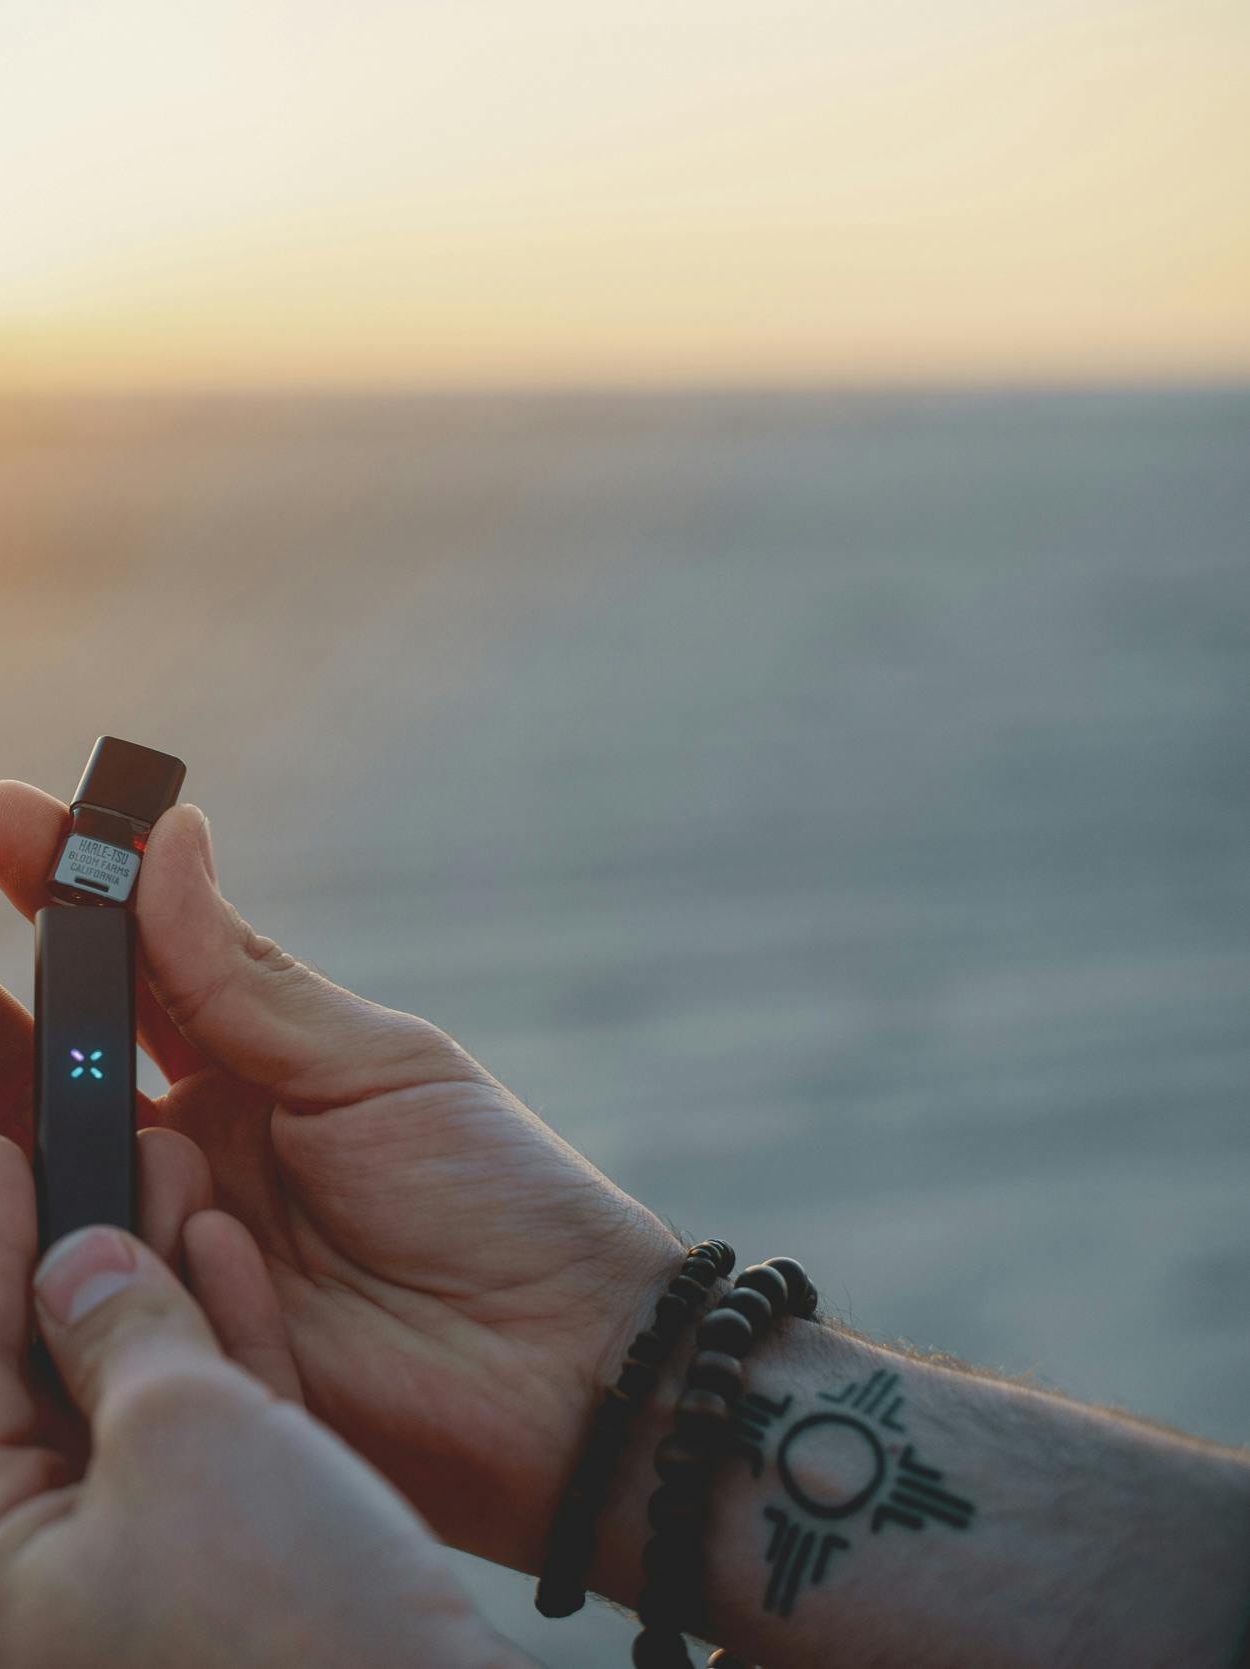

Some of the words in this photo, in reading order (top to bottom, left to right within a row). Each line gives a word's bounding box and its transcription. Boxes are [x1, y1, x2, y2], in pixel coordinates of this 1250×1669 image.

[68, 851, 100, 866] BLOOM
[101, 862, 130, 877] FARMS
[78, 839, 130, 865] HARLE-TSU
[70, 862, 120, 885] CALIFORNIA
